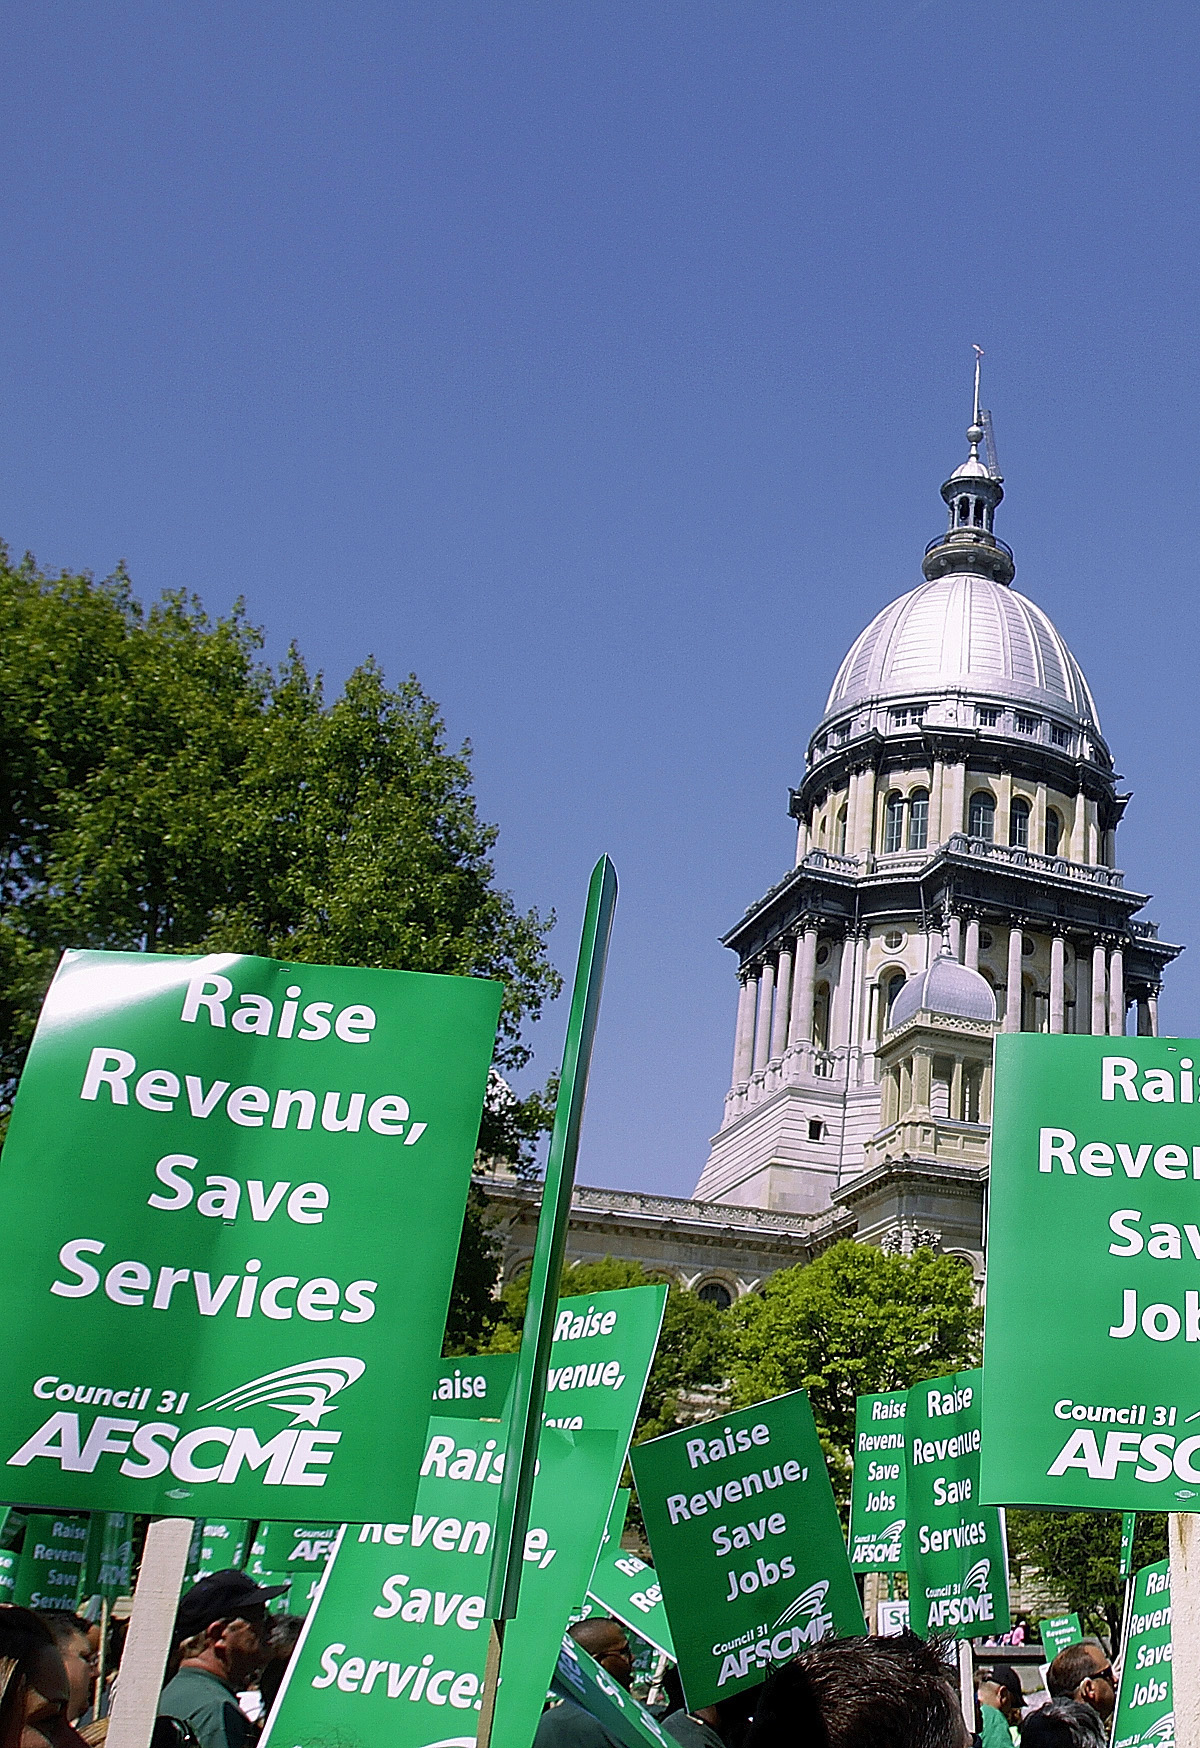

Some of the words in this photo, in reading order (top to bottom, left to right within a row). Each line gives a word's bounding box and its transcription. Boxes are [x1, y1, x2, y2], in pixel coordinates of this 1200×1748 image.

[181, 976, 377, 1044] Raise
[80, 1047, 428, 1145] Revenue,
[147, 1154, 330, 1224] Save
[49, 1238, 378, 1324] Services
[552, 1305, 617, 1342] Raise
[432, 1369, 487, 1401] aise
[547, 1360, 626, 1392] venue,
[33, 1376, 150, 1410] Council
[156, 1389, 190, 1415] 31
[927, 1387, 973, 1418] Raise
[1054, 1399, 1146, 1425] Council
[1152, 1406, 1177, 1427] 31
[6, 1411, 343, 1487] AFSCME
[686, 1424, 770, 1469] Raise
[858, 1432, 905, 1452] Revenu
[419, 1435, 540, 1485] Rais
[867, 1461, 900, 1482] Save
[666, 1460, 808, 1525] Revenue,
[864, 1490, 896, 1513] Jobs
[933, 1477, 972, 1506] Save
[293, 1527, 334, 1539] Council
[712, 1512, 787, 1557] Save
[919, 1518, 987, 1554] Services
[851, 1542, 902, 1564] AFSCME
[726, 1556, 796, 1602] Jobs
[925, 1584, 952, 1599] Council
[1146, 1568, 1172, 1596] Rai
[372, 1574, 486, 1630] Save
[927, 1593, 994, 1628] AFSCME
[1129, 1606, 1171, 1639] Reven
[712, 1629, 755, 1656] Council
[756, 1623, 768, 1638] 31
[1135, 1643, 1173, 1670] Save
[1129, 1677, 1168, 1709] Jobs
